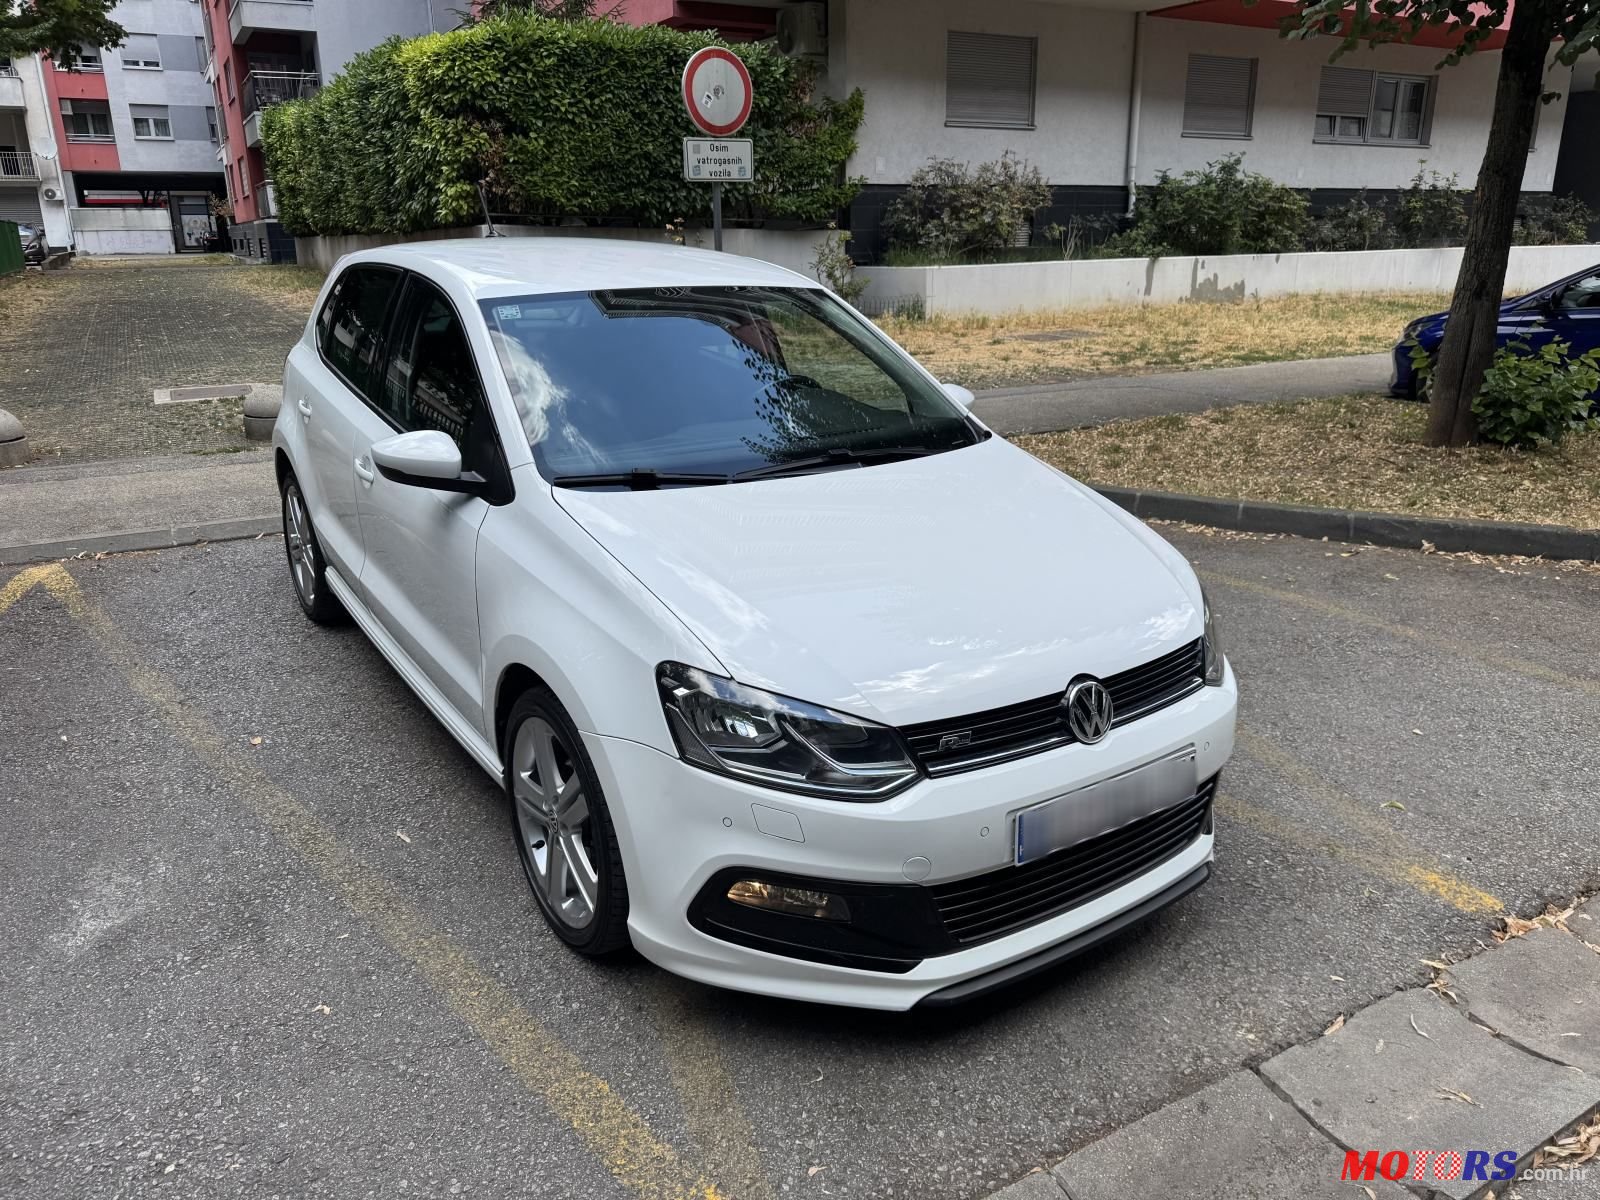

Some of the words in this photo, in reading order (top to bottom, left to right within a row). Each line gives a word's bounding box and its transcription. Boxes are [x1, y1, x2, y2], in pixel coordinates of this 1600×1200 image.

[709, 143, 728, 152] Osim
[697, 156, 742, 166] vatrogasnih
[709, 169, 731, 177] vozila
